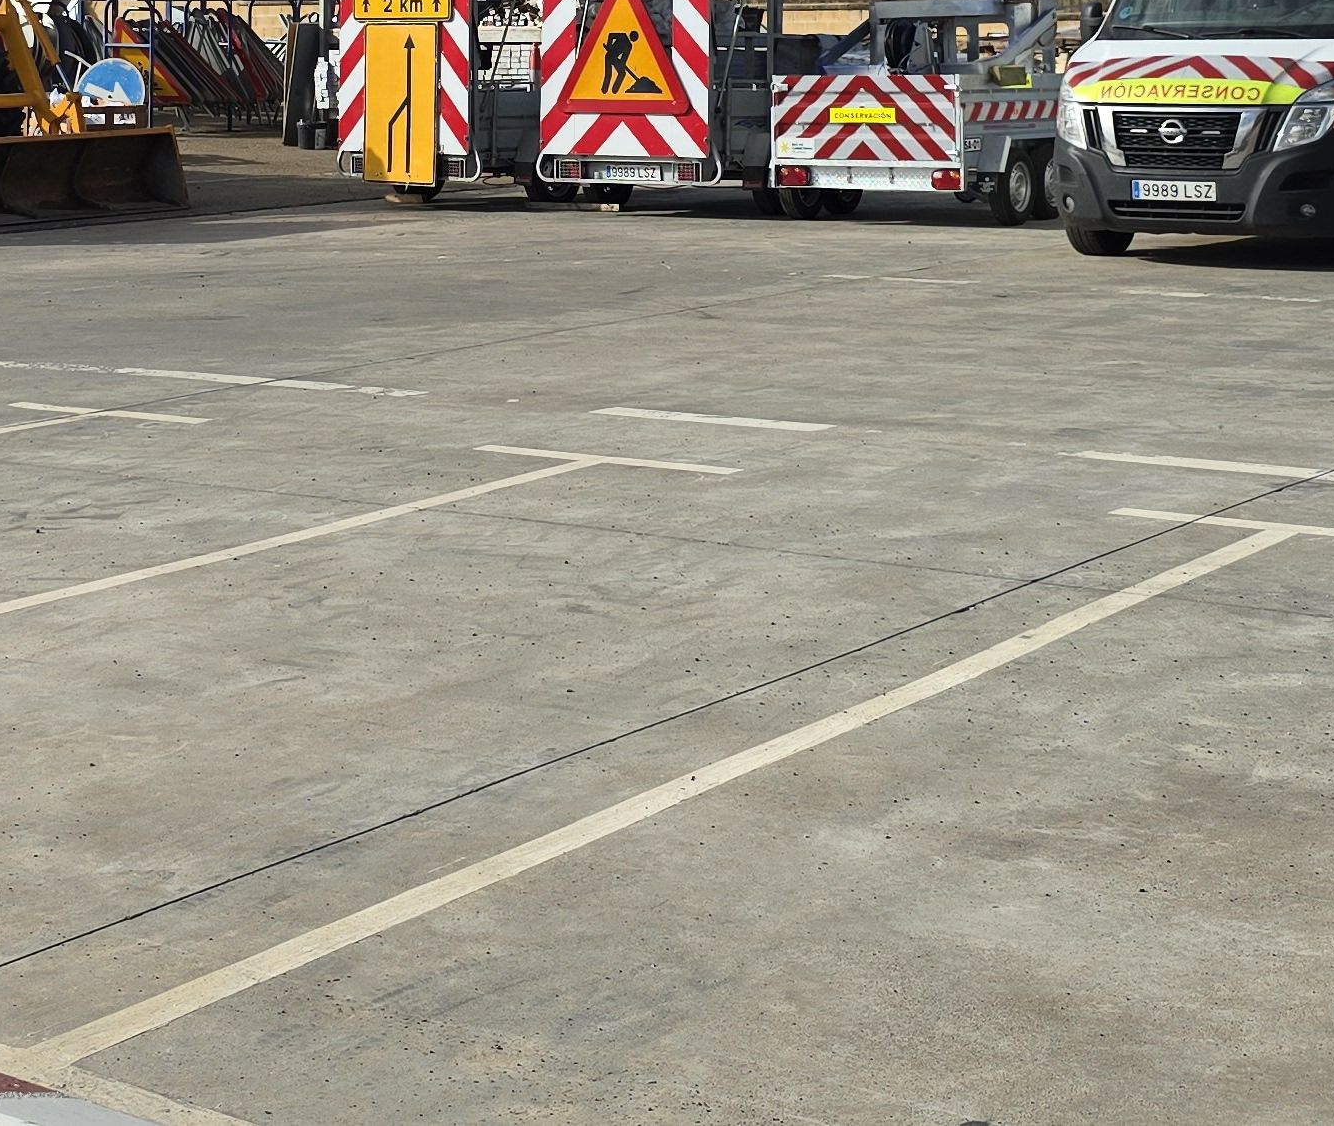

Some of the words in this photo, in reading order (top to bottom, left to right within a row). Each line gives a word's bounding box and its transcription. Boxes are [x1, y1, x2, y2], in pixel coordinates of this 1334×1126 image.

[834, 111, 892, 119] CONSERVACIÓN
[612, 166, 635, 178] 9989
[638, 166, 657, 179] LSZ
[1142, 183, 1179, 198] 9989
[1184, 184, 1213, 199] LSZ
